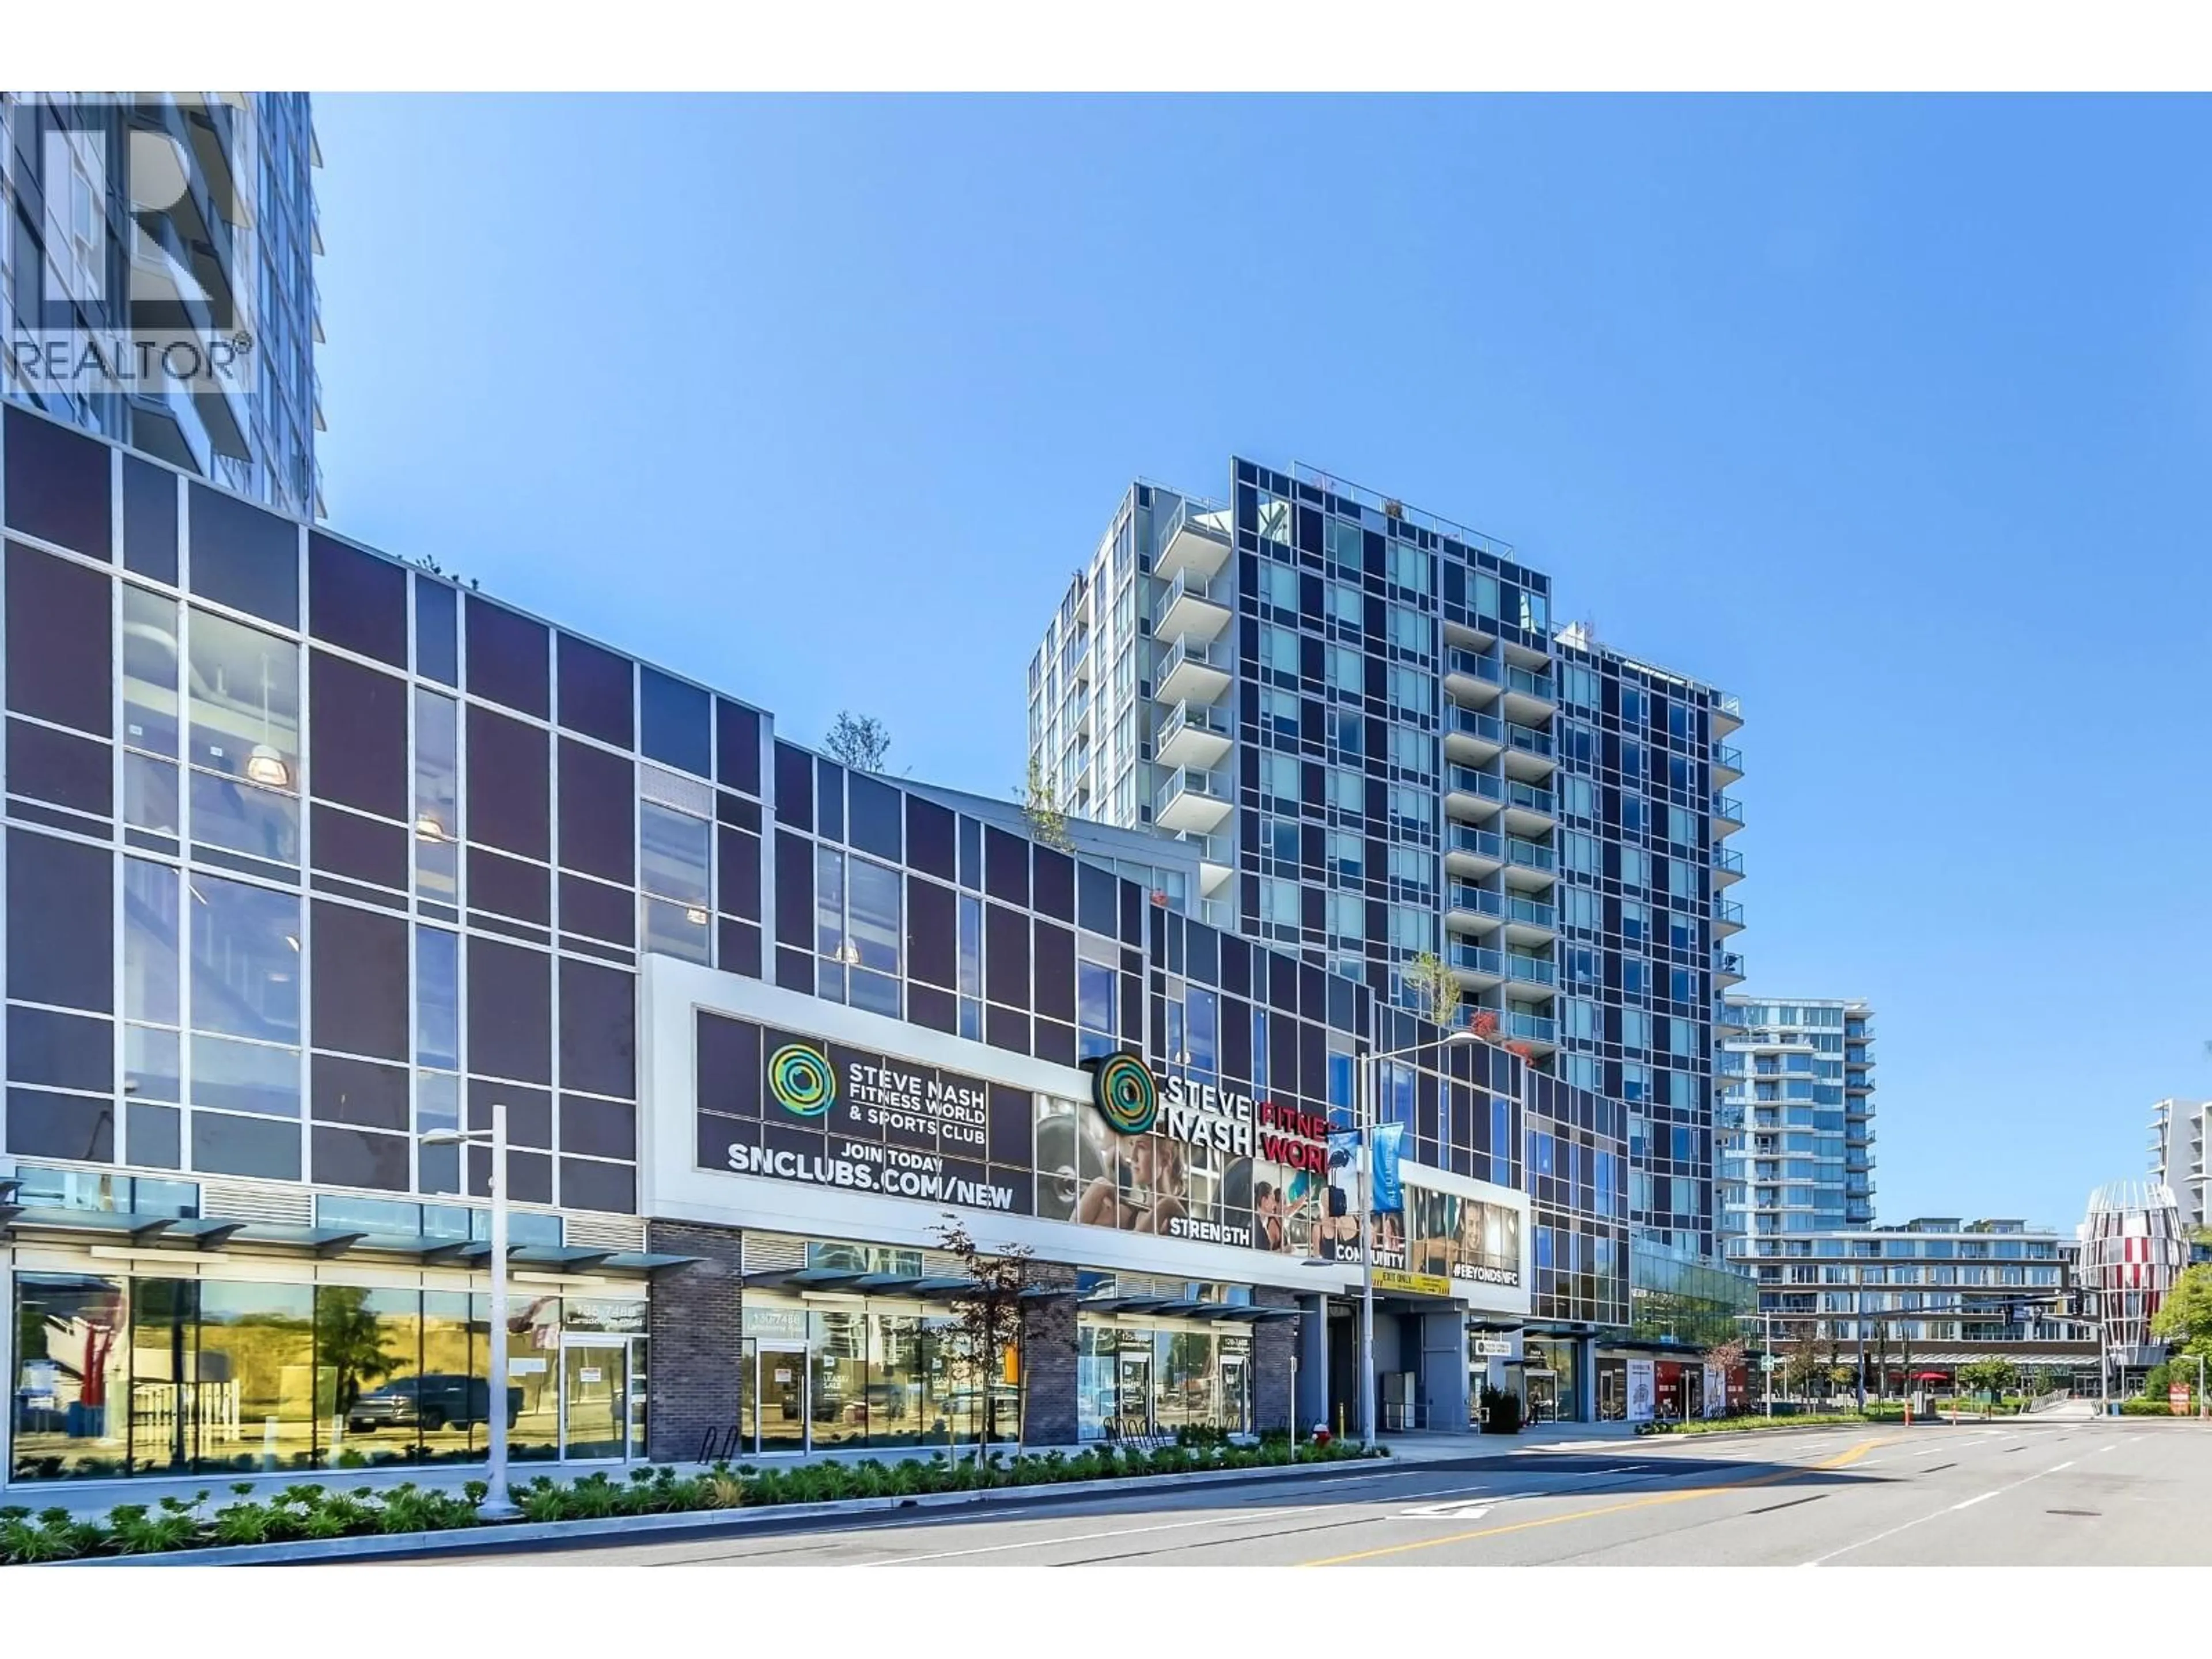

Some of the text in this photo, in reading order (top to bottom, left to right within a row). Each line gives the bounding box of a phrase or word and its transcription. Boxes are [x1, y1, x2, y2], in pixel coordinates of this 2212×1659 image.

[850, 1063, 984, 1110] STEVE NASH
[850, 1082, 985, 1124] FITNESS WORLD
[1168, 1075, 1252, 1123] STEVE
[850, 1105, 985, 1145] & SPORTS CLUB
[1168, 1107, 1253, 1158] NASH
[728, 1143, 1013, 1209] SNCLUBS.COM/NEW
[841, 1142, 942, 1173] JOIN TODAY
[1170, 1216, 1249, 1245] STRENGTH
[1336, 1244, 1404, 1268] COMUNITY
